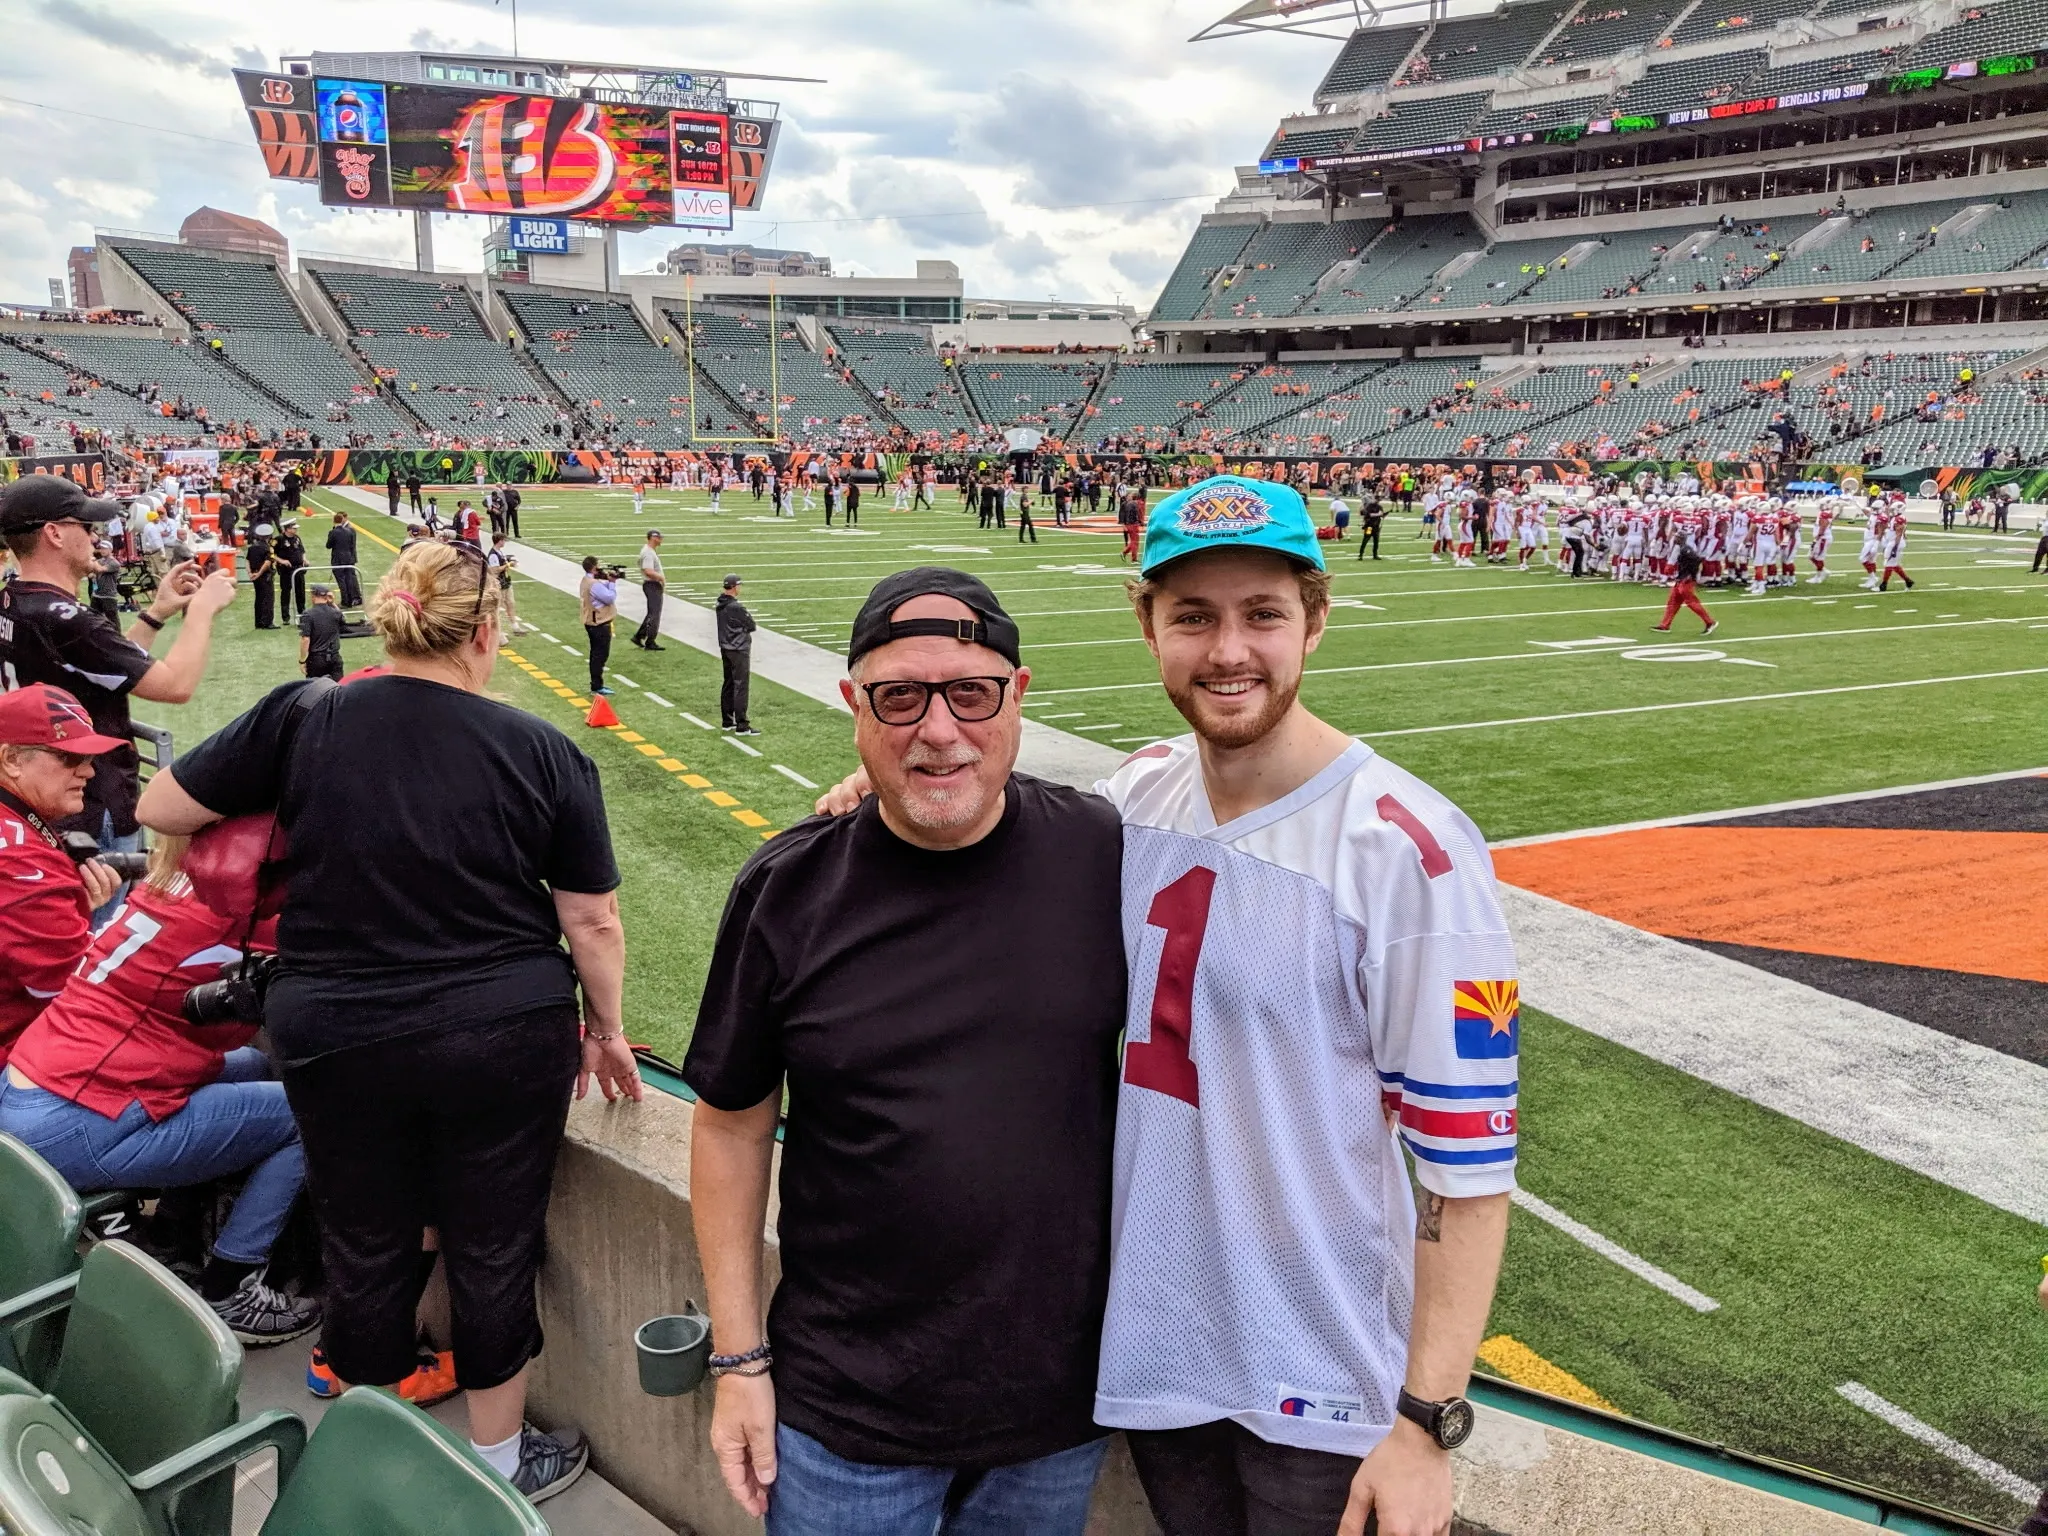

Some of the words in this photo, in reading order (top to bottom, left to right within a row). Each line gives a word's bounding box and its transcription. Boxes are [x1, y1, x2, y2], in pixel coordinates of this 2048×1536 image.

[1669, 111, 1689, 124] NEW
[1691, 108, 1709, 121] ERA
[1745, 99, 1765, 114] CAPS
[1766, 97, 1778, 110] AT
[1779, 90, 1821, 108] BENGALS
[1822, 87, 1841, 101] PRO
[1843, 83, 1869, 97] SHOP
[676, 122, 689, 131] NEXT
[690, 124, 705, 133] HOME
[705, 125, 720, 134] GAME
[680, 159, 696, 169] SUN
[1316, 157, 1343, 166] TICKETS
[1343, 155, 1378, 165] AVAILABLE
[1379, 152, 1394, 161] NOW
[1402, 148, 1433, 158] SECTIONS
[703, 172, 715, 182] PM
[682, 192, 723, 215] vive
[520, 220, 557, 236] BUD
[513, 233, 565, 250] LIGHT
[1204, 487, 1242, 496] SUPER
[1193, 496, 1253, 521] XXX
[1204, 522, 1240, 530] BOWL
[1760, 524, 1775, 536] 52
[1376, 793, 1454, 880] 1
[1124, 865, 1218, 1110] 1
[1331, 1409, 1350, 1423] 44
